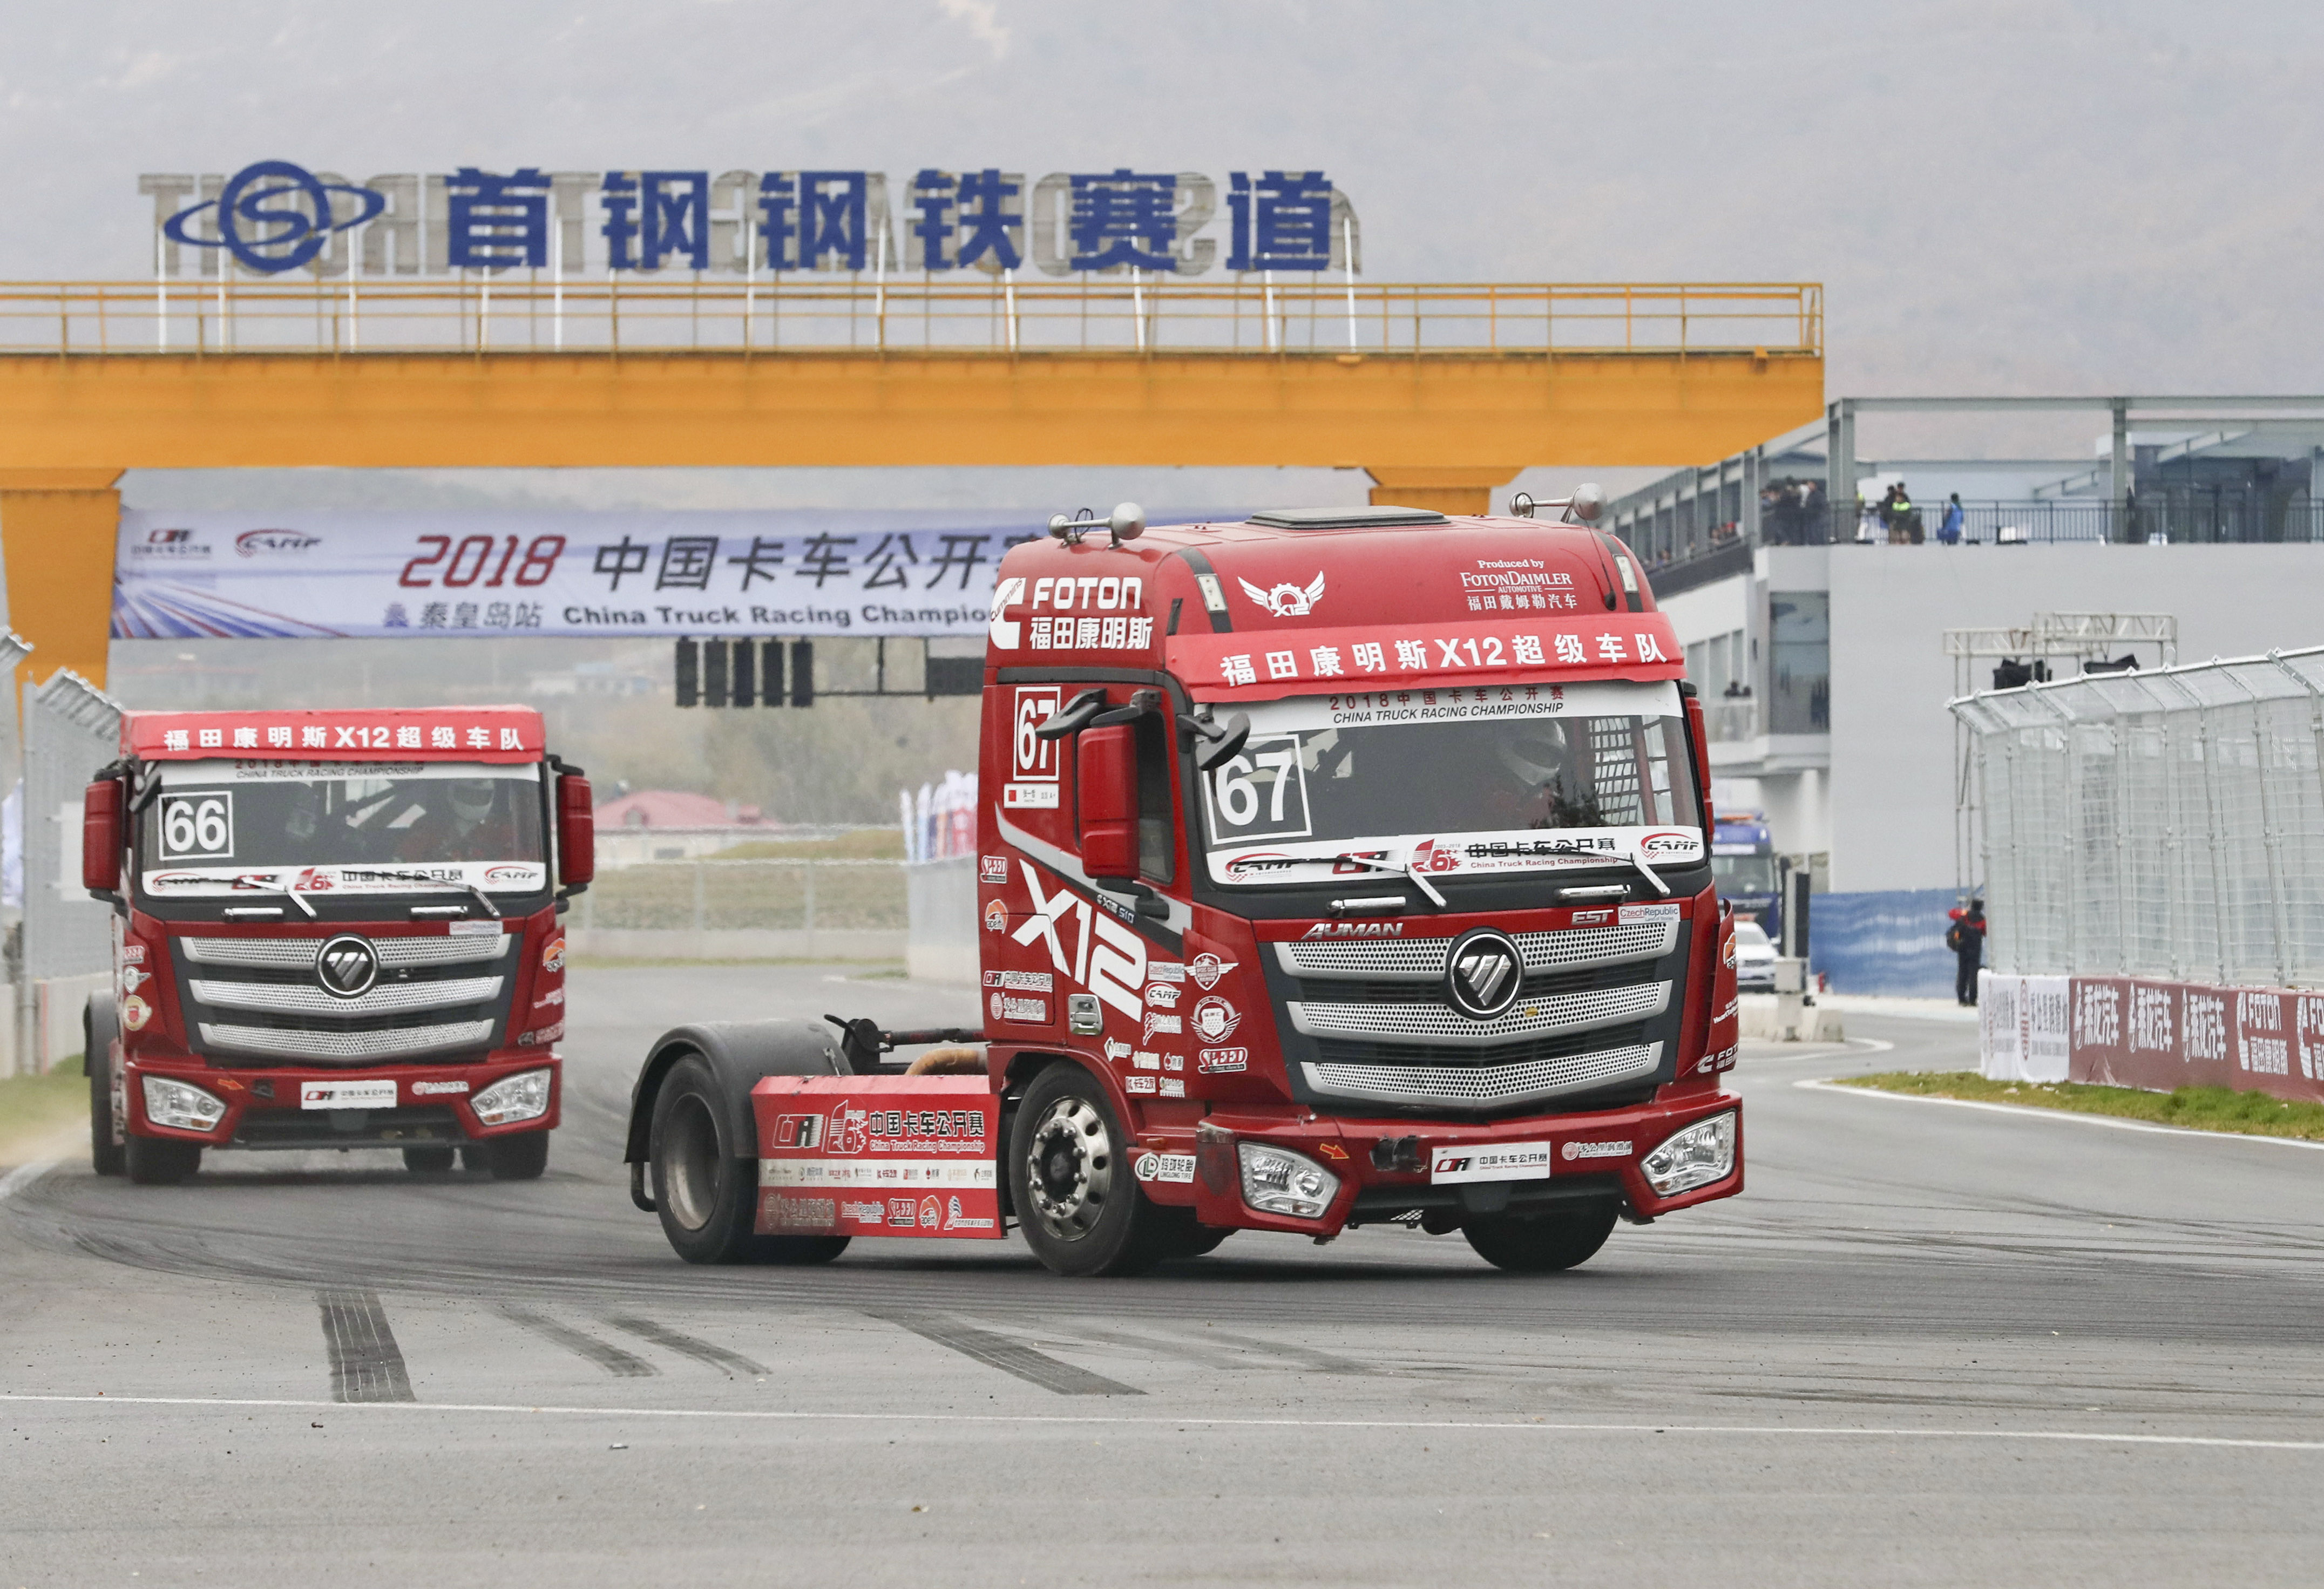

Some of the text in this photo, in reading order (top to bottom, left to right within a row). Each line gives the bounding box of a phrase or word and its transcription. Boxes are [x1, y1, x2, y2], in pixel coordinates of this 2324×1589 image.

[398, 534, 567, 588] 2018
[1477, 559, 1544, 569] Produced by
[1032, 577, 1142, 609] FOTON
[1467, 594, 1577, 611] 福田戴姆勒汽车
[418, 601, 541, 630] 秦皇岛站
[564, 605, 991, 628] China Truck Racing Champio
[1029, 616, 1153, 649] 福田康明斯
[1221, 633, 1668, 687] 福田康明斯X12超级车队
[1333, 703, 1563, 723] CHINA TRUCK RACING CHAMPIONSHIP
[164, 726, 524, 751] 福田康明斯X12超级车队
[1018, 698, 1056, 770] 67
[236, 766, 424, 779] CHINA TRUCK RACING CHAMPIONSHIP
[1215, 751, 1292, 826] 67
[165, 800, 227, 853] 66
[1526, 858, 1555, 867] Racing
[1557, 855, 1618, 866] Championship
[1571, 909, 1614, 925] EST
[1011, 859, 1147, 1023] X12
[1301, 923, 1403, 940] AUMAN
[2248, 993, 2281, 1031] FOTON
[1201, 1050, 1245, 1066] SPEED
[1718, 1043, 1738, 1060] FOT
[870, 1111, 985, 1137] 中国卡车公开赛
[870, 1140, 985, 1153] China Truck Racing Championship
[1480, 1153, 1547, 1164] 中国卡车公开赛
